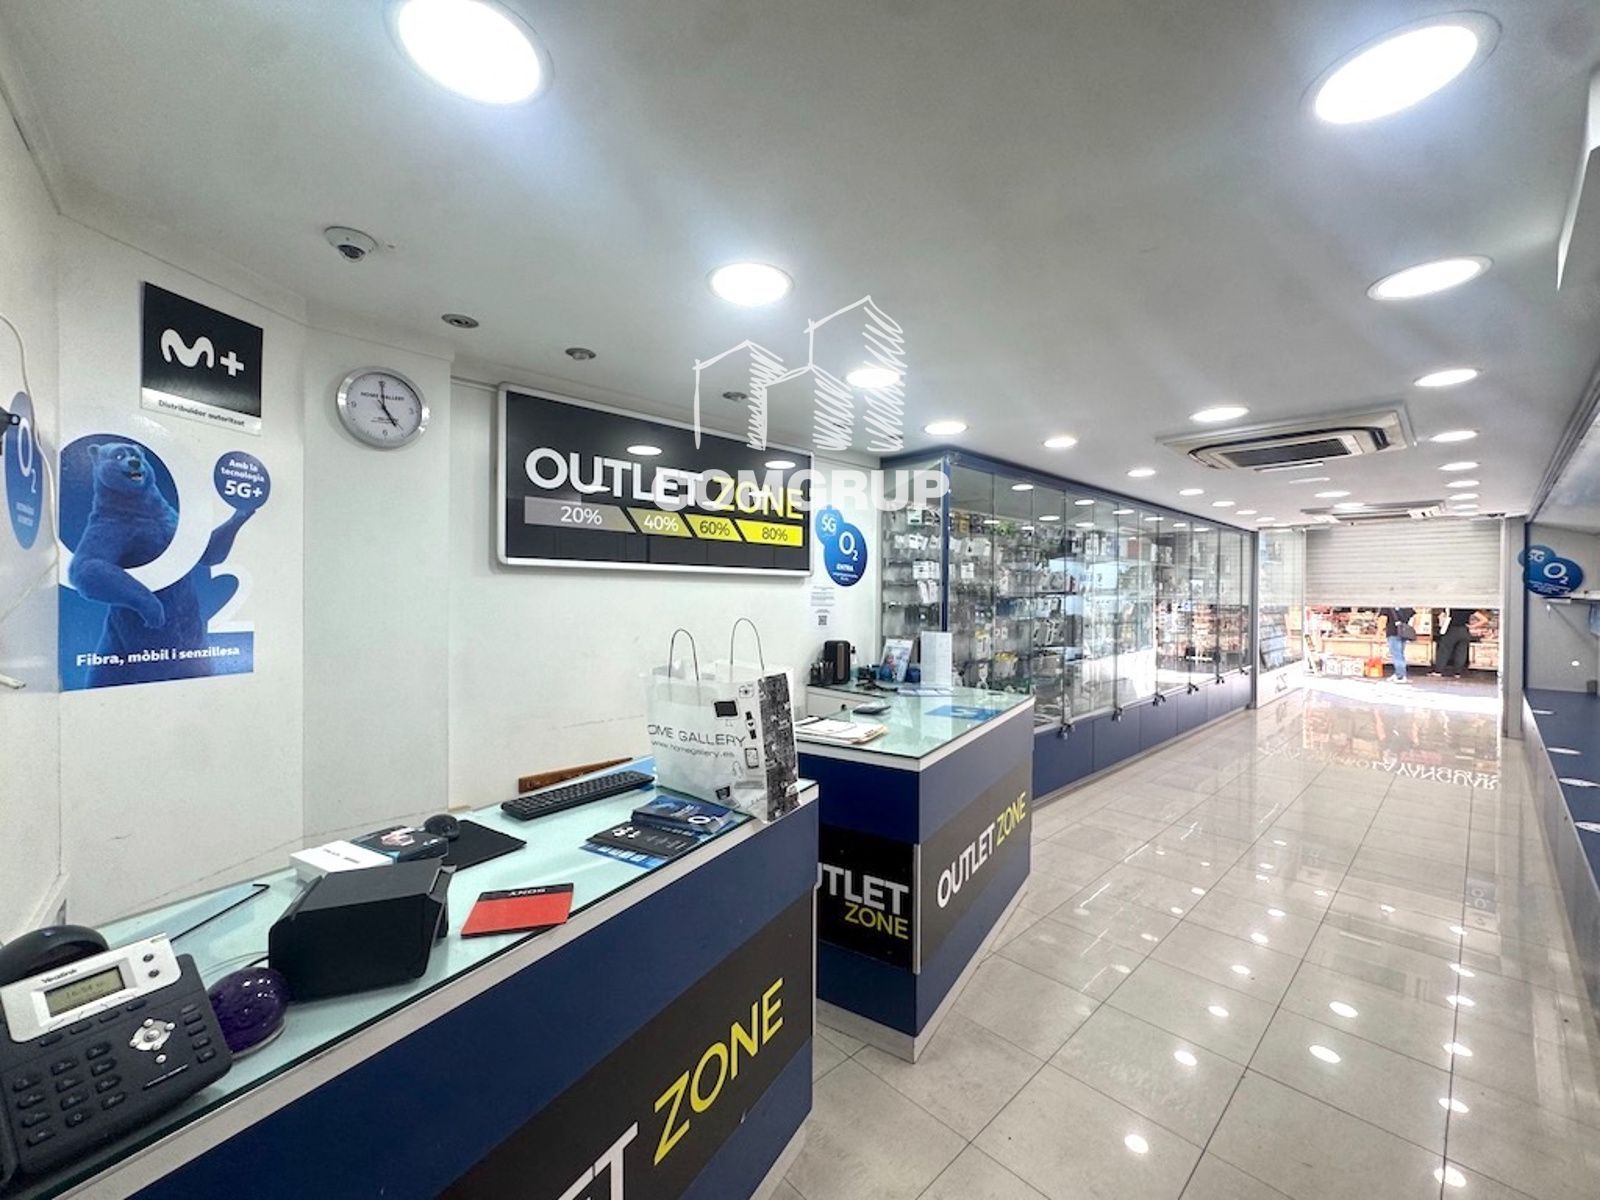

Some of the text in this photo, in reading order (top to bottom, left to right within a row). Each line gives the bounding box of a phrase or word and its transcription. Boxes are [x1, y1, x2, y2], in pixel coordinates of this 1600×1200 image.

[221, 466, 265, 483] tecnologia
[228, 458, 258, 471] Amb la
[223, 479, 264, 499] 5G+
[524, 446, 804, 520] OUTLET ZONE
[560, 506, 602, 526] 20%
[643, 514, 680, 532] 40%
[699, 520, 731, 538] 60%
[762, 527, 789, 542] 80%
[76, 644, 240, 668] Fibra, mòbil i senzillesa
[678, 730, 746, 748] GALLERY
[937, 792, 1027, 908] OUTLET ZONE
[844, 901, 910, 940] ZONE
[653, 977, 785, 1167] ZONE
